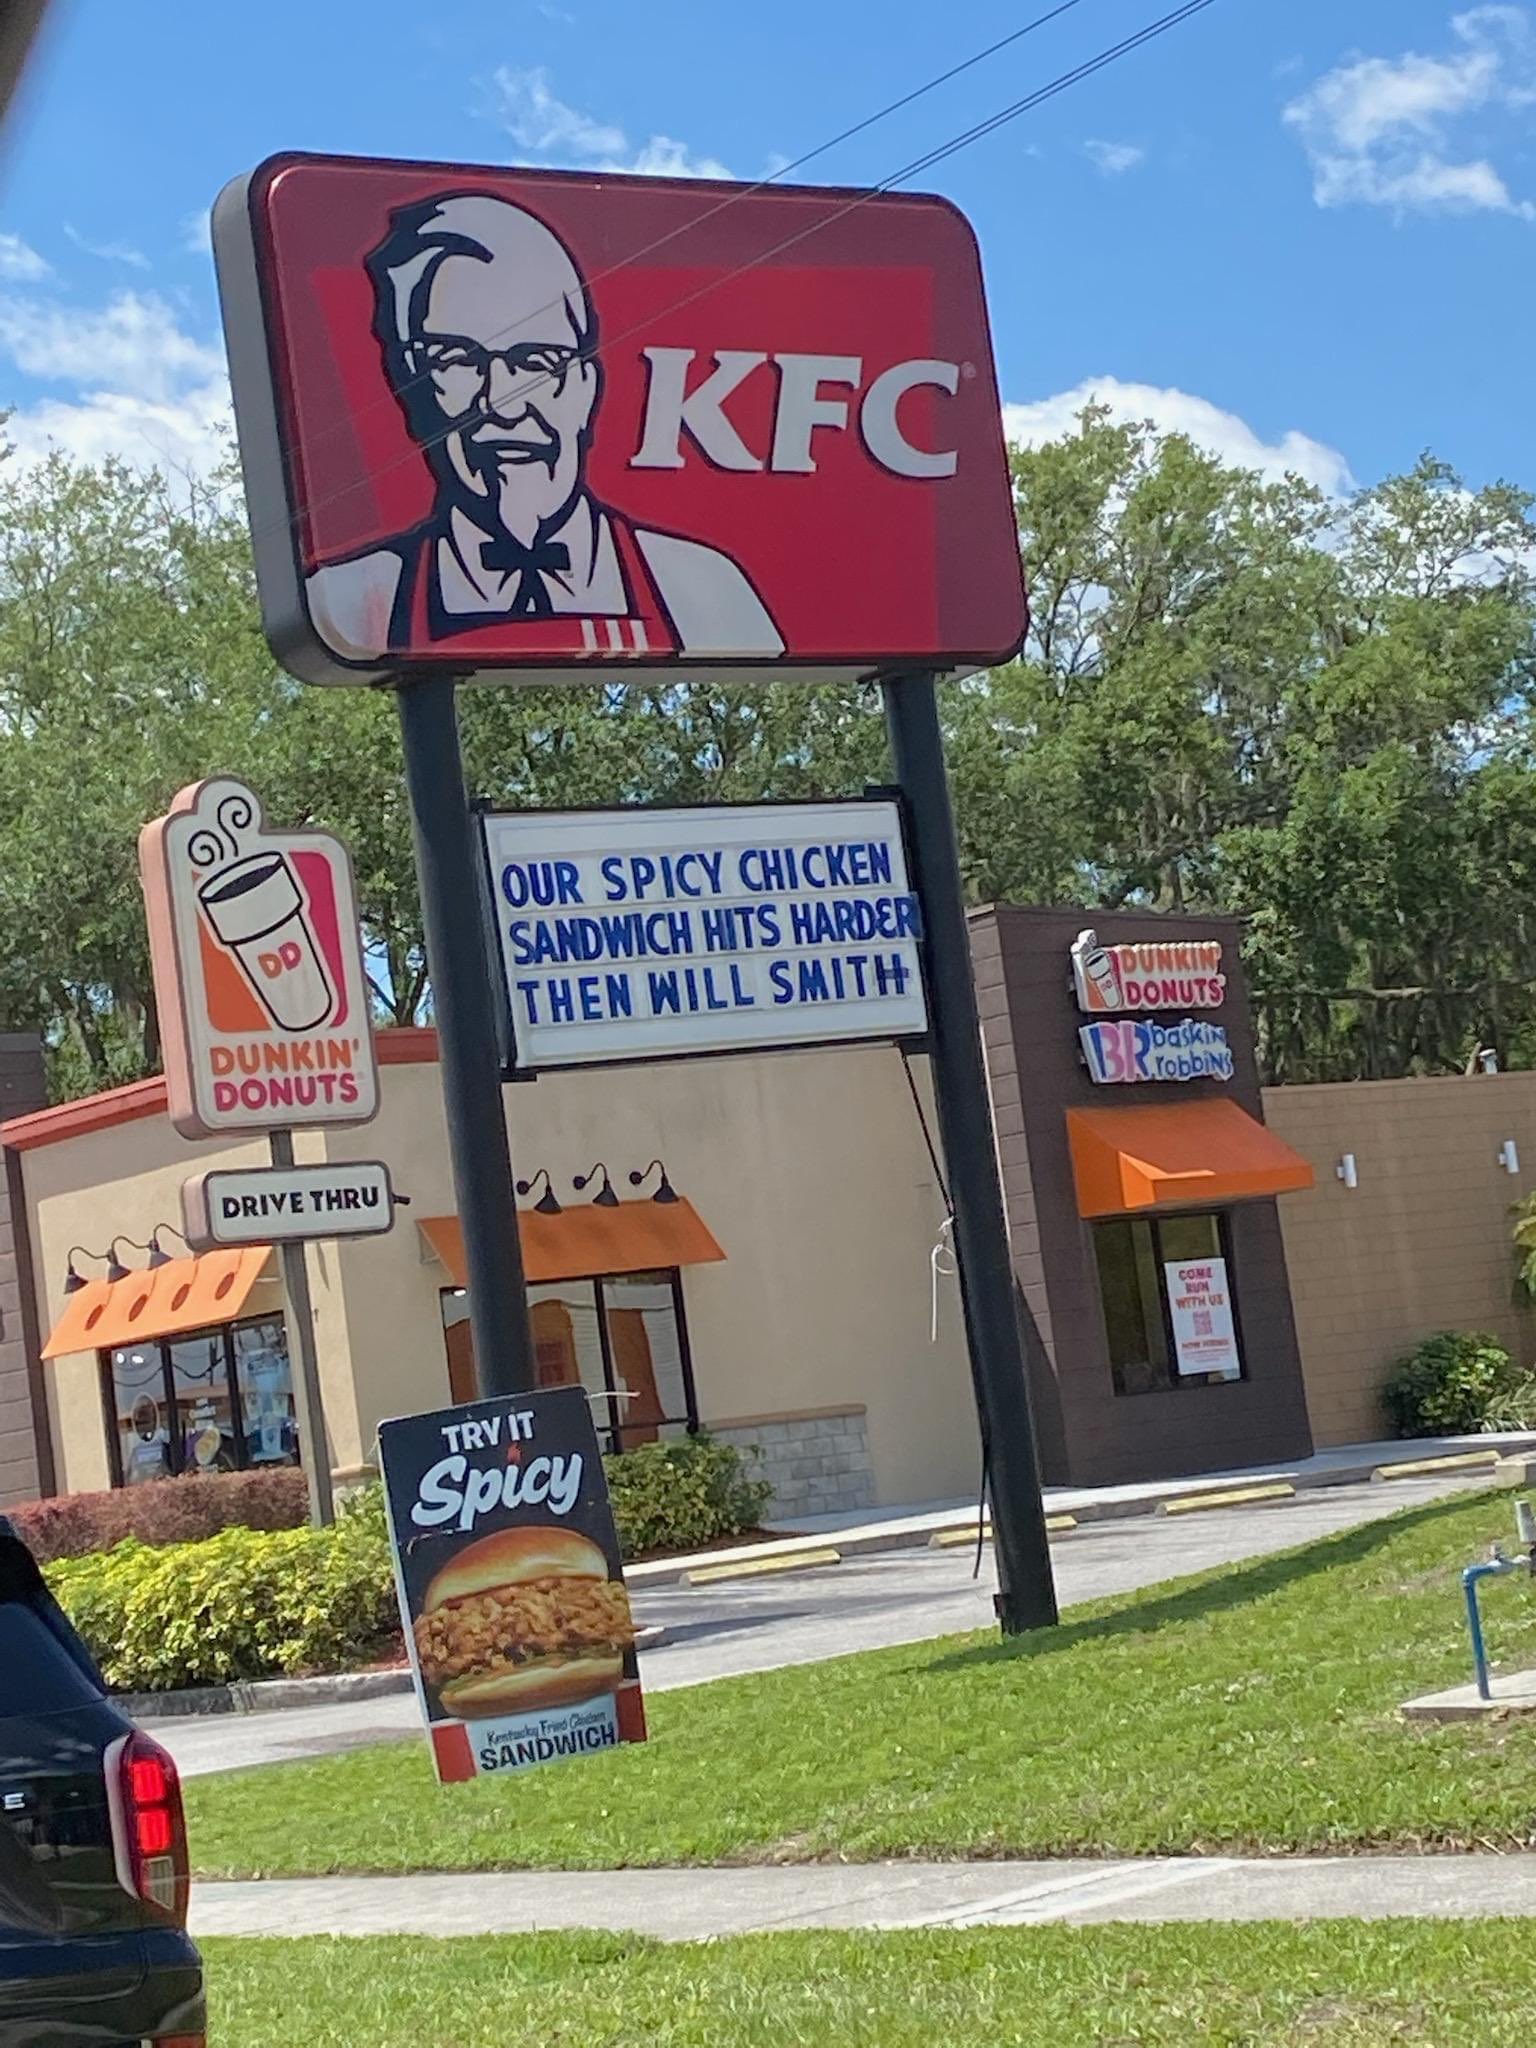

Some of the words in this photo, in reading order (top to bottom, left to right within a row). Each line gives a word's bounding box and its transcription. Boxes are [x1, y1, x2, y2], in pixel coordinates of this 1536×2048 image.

[630, 347, 959, 478] KFC
[502, 861, 584, 909] OUR
[601, 851, 722, 900] SPICY
[739, 842, 892, 892] CHICKEN
[510, 911, 694, 966] SANDWICH
[702, 907, 782, 952] HITS
[790, 896, 923, 945] HARDER
[258, 941, 303, 980] DD
[517, 973, 631, 1024] THEN
[649, 964, 754, 1016] WILL
[769, 954, 910, 1004] SMITH
[1126, 979, 1223, 1005] DONUTS
[209, 1038, 360, 1076] DUNKIN'
[1089, 1022, 1150, 1080] BR
[213, 1073, 359, 1112] DONUTS
[222, 1192, 304, 1220] DRIVE
[309, 1186, 379, 1213] THRU
[1178, 1266, 1213, 1281] COME
[1175, 1295, 1206, 1309] WITH
[1209, 1293, 1224, 1306] US
[441, 1418, 500, 1454] TRY
[508, 1410, 536, 1442] IT
[410, 1449, 583, 1531] Spicy
[480, 1721, 616, 1771] SANDWICH
[487, 1724, 539, 1746] Kentucky
[539, 1718, 568, 1737] Fried
